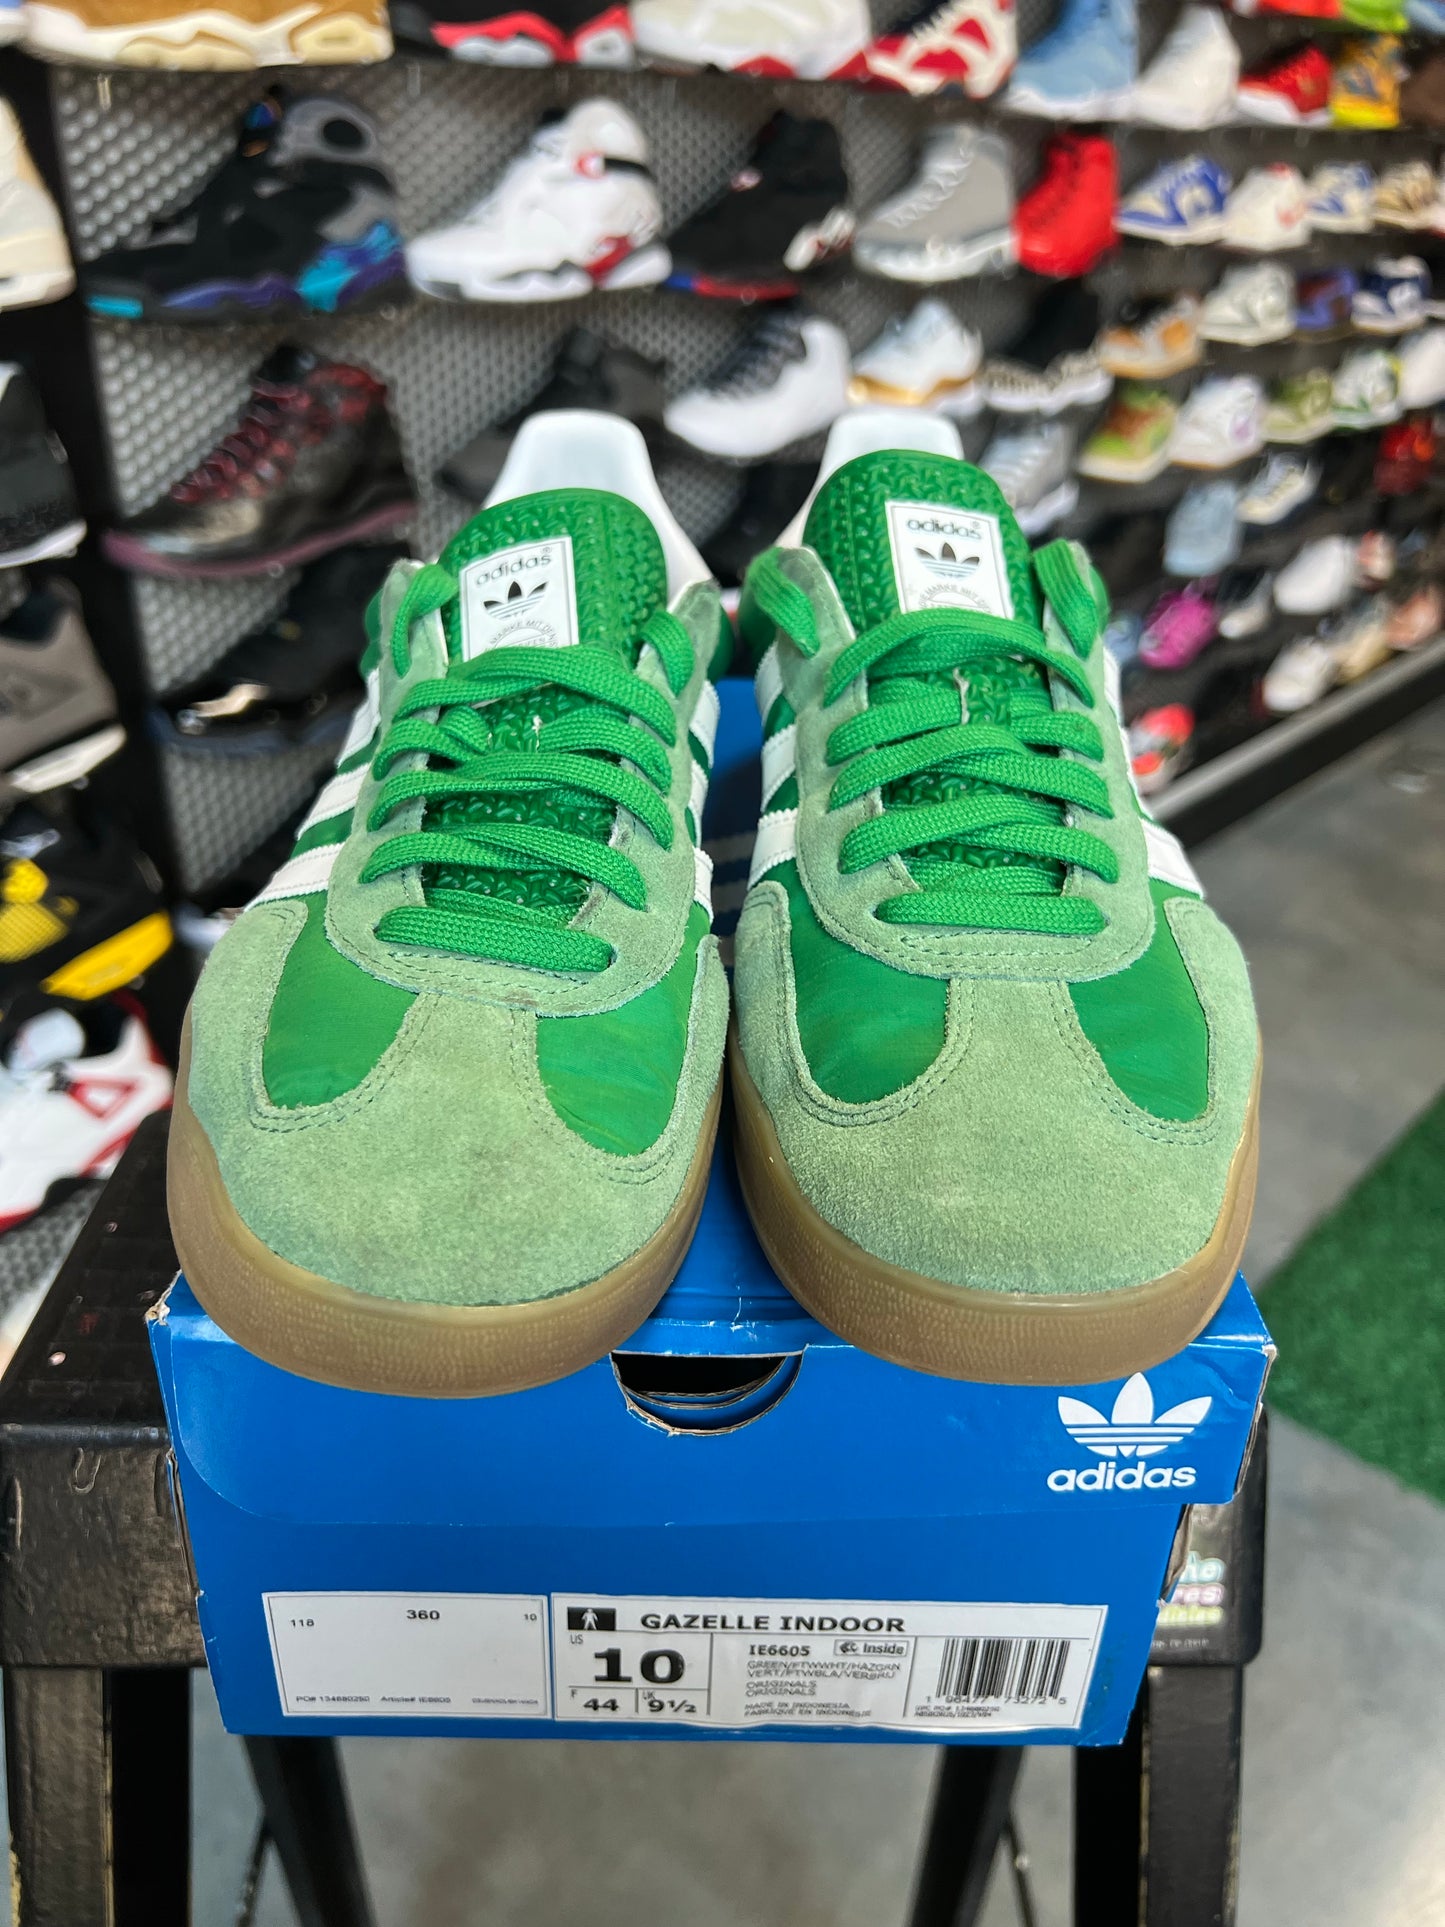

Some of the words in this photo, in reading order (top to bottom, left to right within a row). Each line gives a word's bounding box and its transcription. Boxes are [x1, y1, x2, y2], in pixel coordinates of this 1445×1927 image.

[906, 519, 982, 540] adidas
[476, 554, 552, 586] adidas
[1046, 1461, 1196, 1492] adidas
[406, 1609, 440, 1621] 360
[524, 1613, 537, 1621] 10
[290, 1618, 315, 1628] 118
[640, 1613, 769, 1630] GAZELLE
[780, 1616, 905, 1632] INDOOR
[570, 1634, 583, 1645] US
[749, 1644, 811, 1657] IE6605
[863, 1642, 904, 1655] Inside
[594, 1648, 686, 1684] 10
[746, 1680, 817, 1689] ORIGINALS
[745, 1688, 816, 1697] ORIGINALS
[583, 1698, 619, 1711] 44
